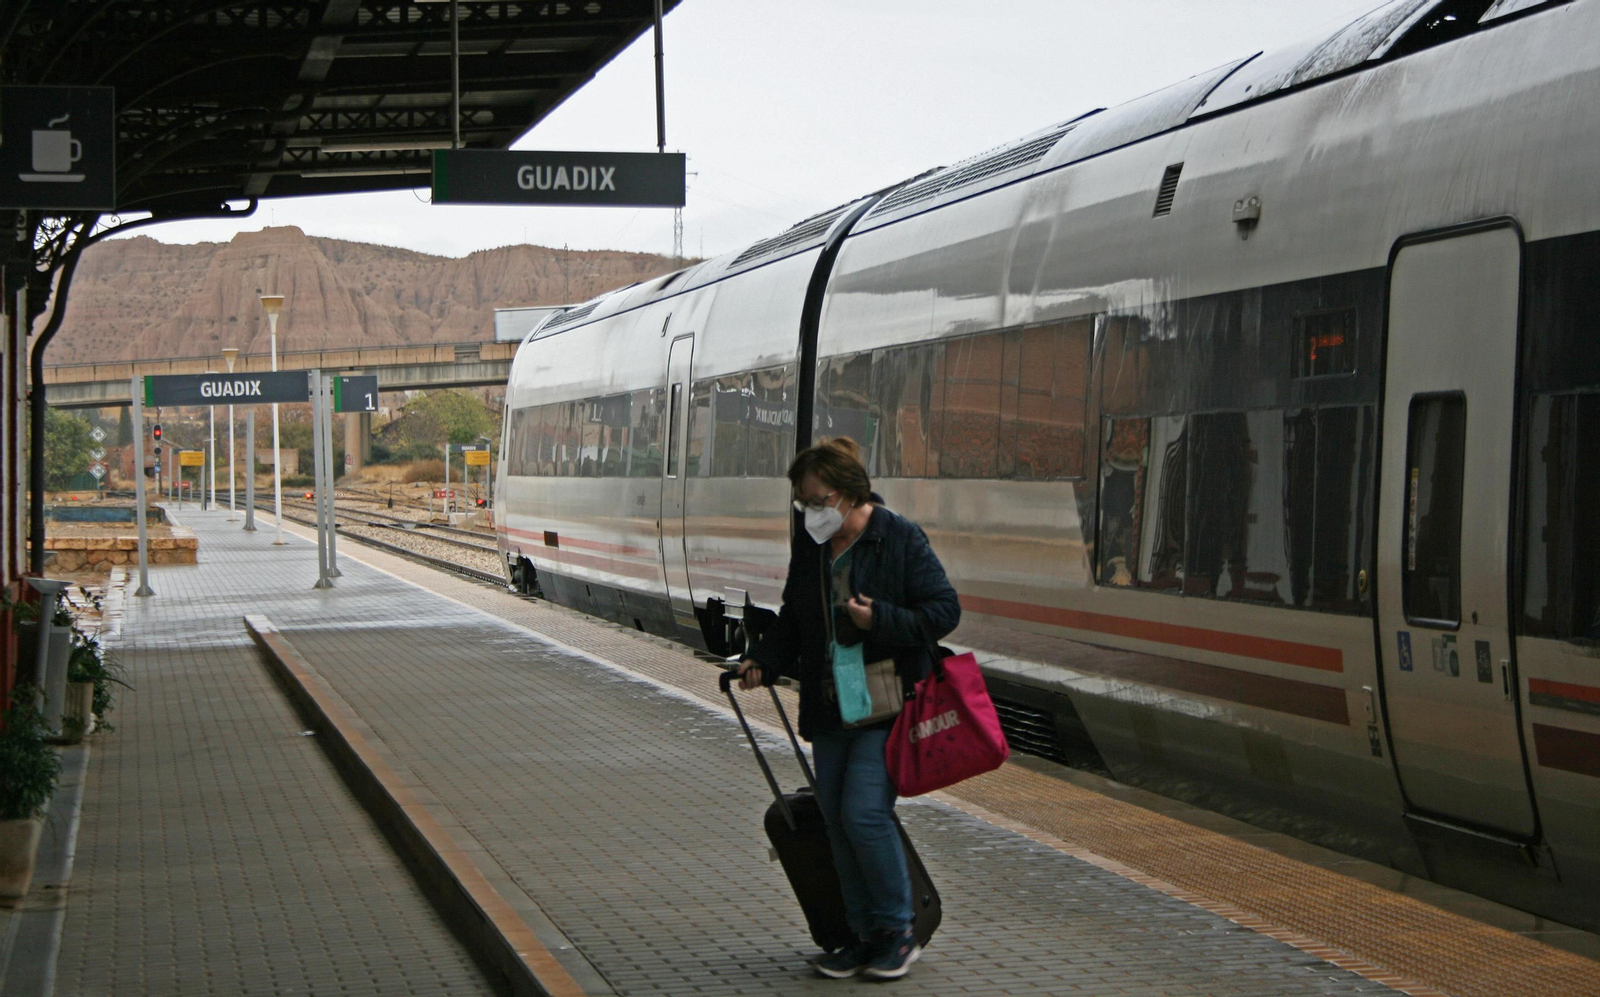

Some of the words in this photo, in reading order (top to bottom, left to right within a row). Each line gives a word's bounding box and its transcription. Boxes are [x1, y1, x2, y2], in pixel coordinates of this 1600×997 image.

[516, 165, 616, 191] GUADIX
[200, 380, 262, 398] GUADIX
[364, 393, 376, 411] 1
